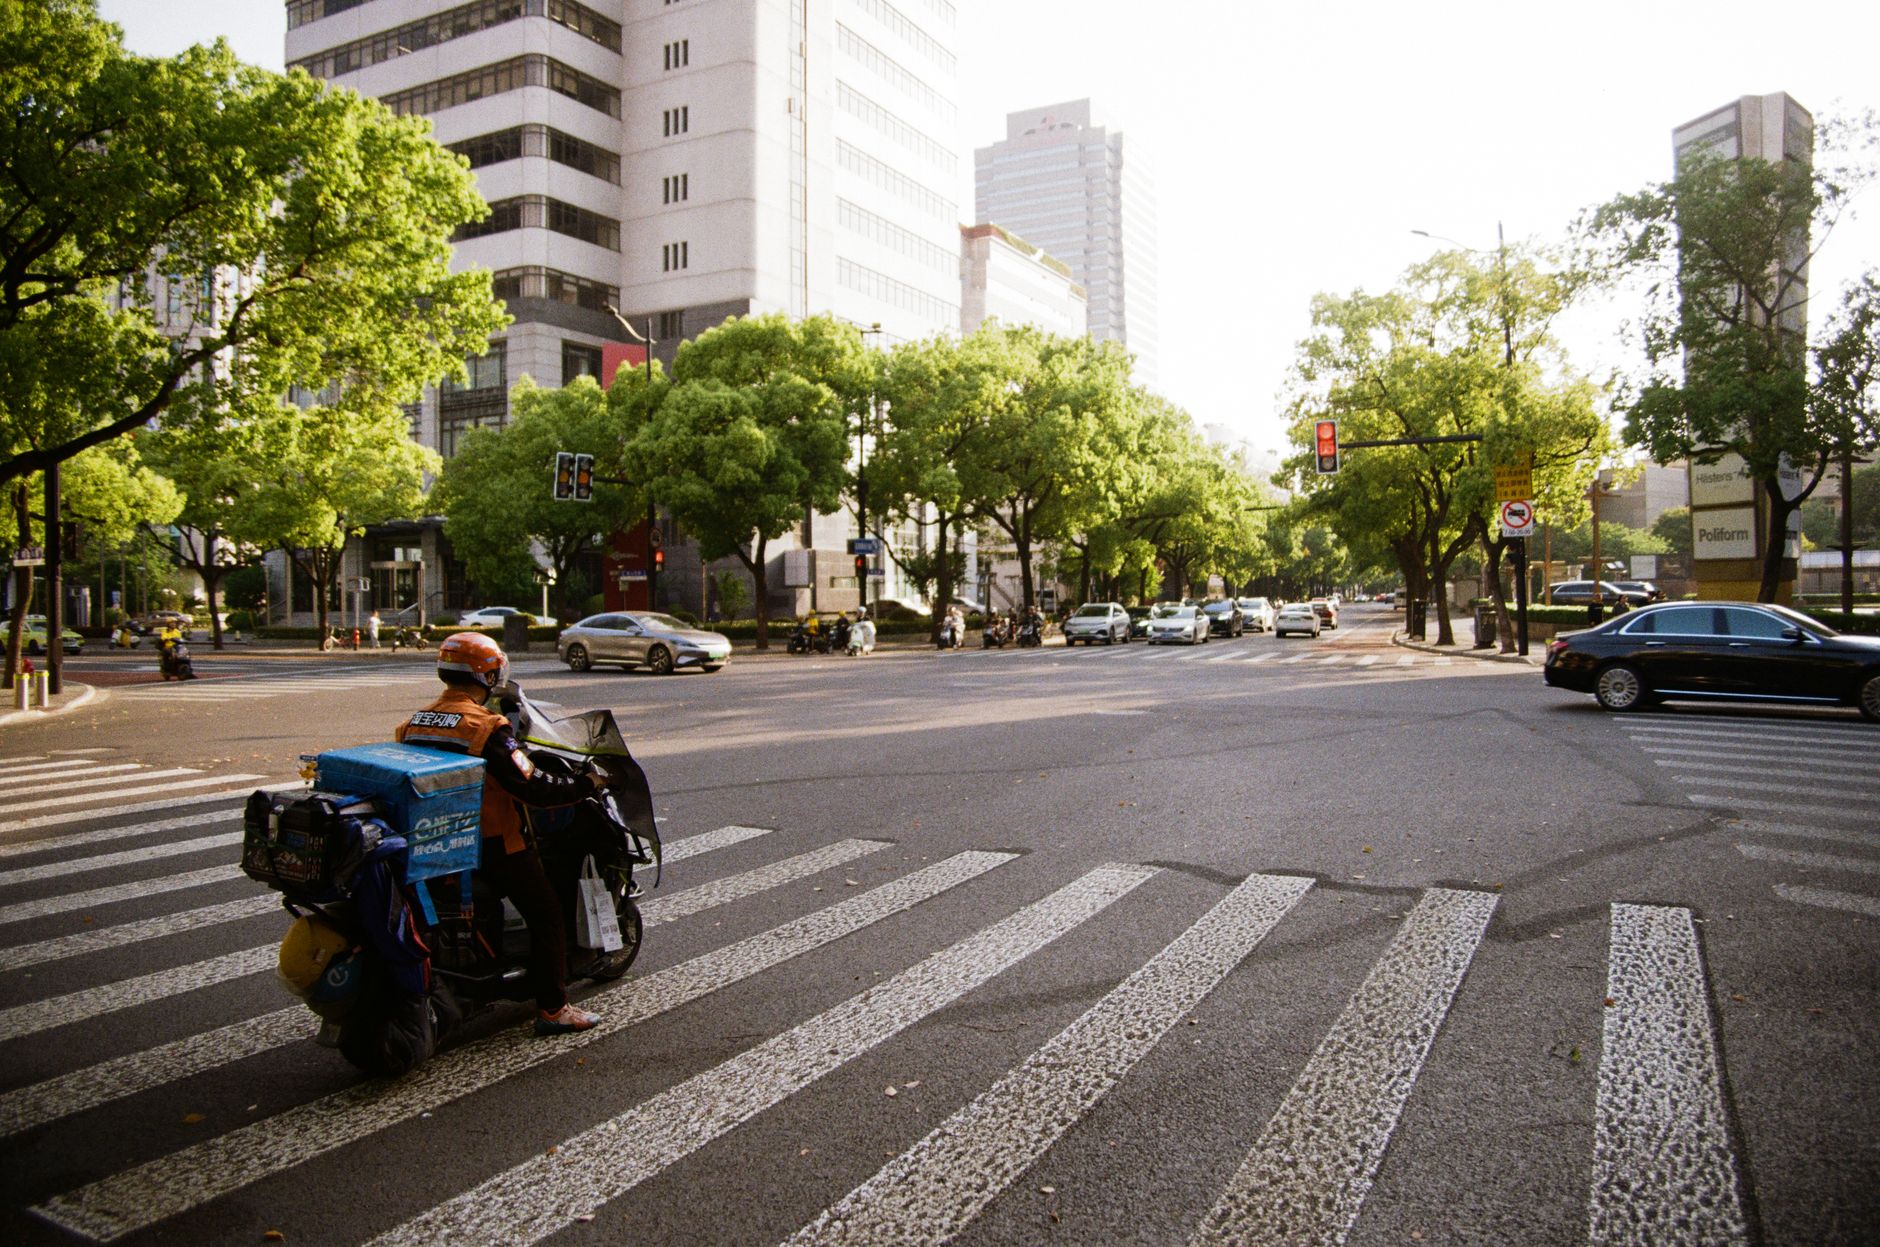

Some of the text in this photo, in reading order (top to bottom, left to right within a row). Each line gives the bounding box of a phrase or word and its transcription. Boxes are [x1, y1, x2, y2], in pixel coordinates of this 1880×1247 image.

[1698, 527, 1748, 542] Poliform
[410, 711, 462, 728] 淘宝闪购
